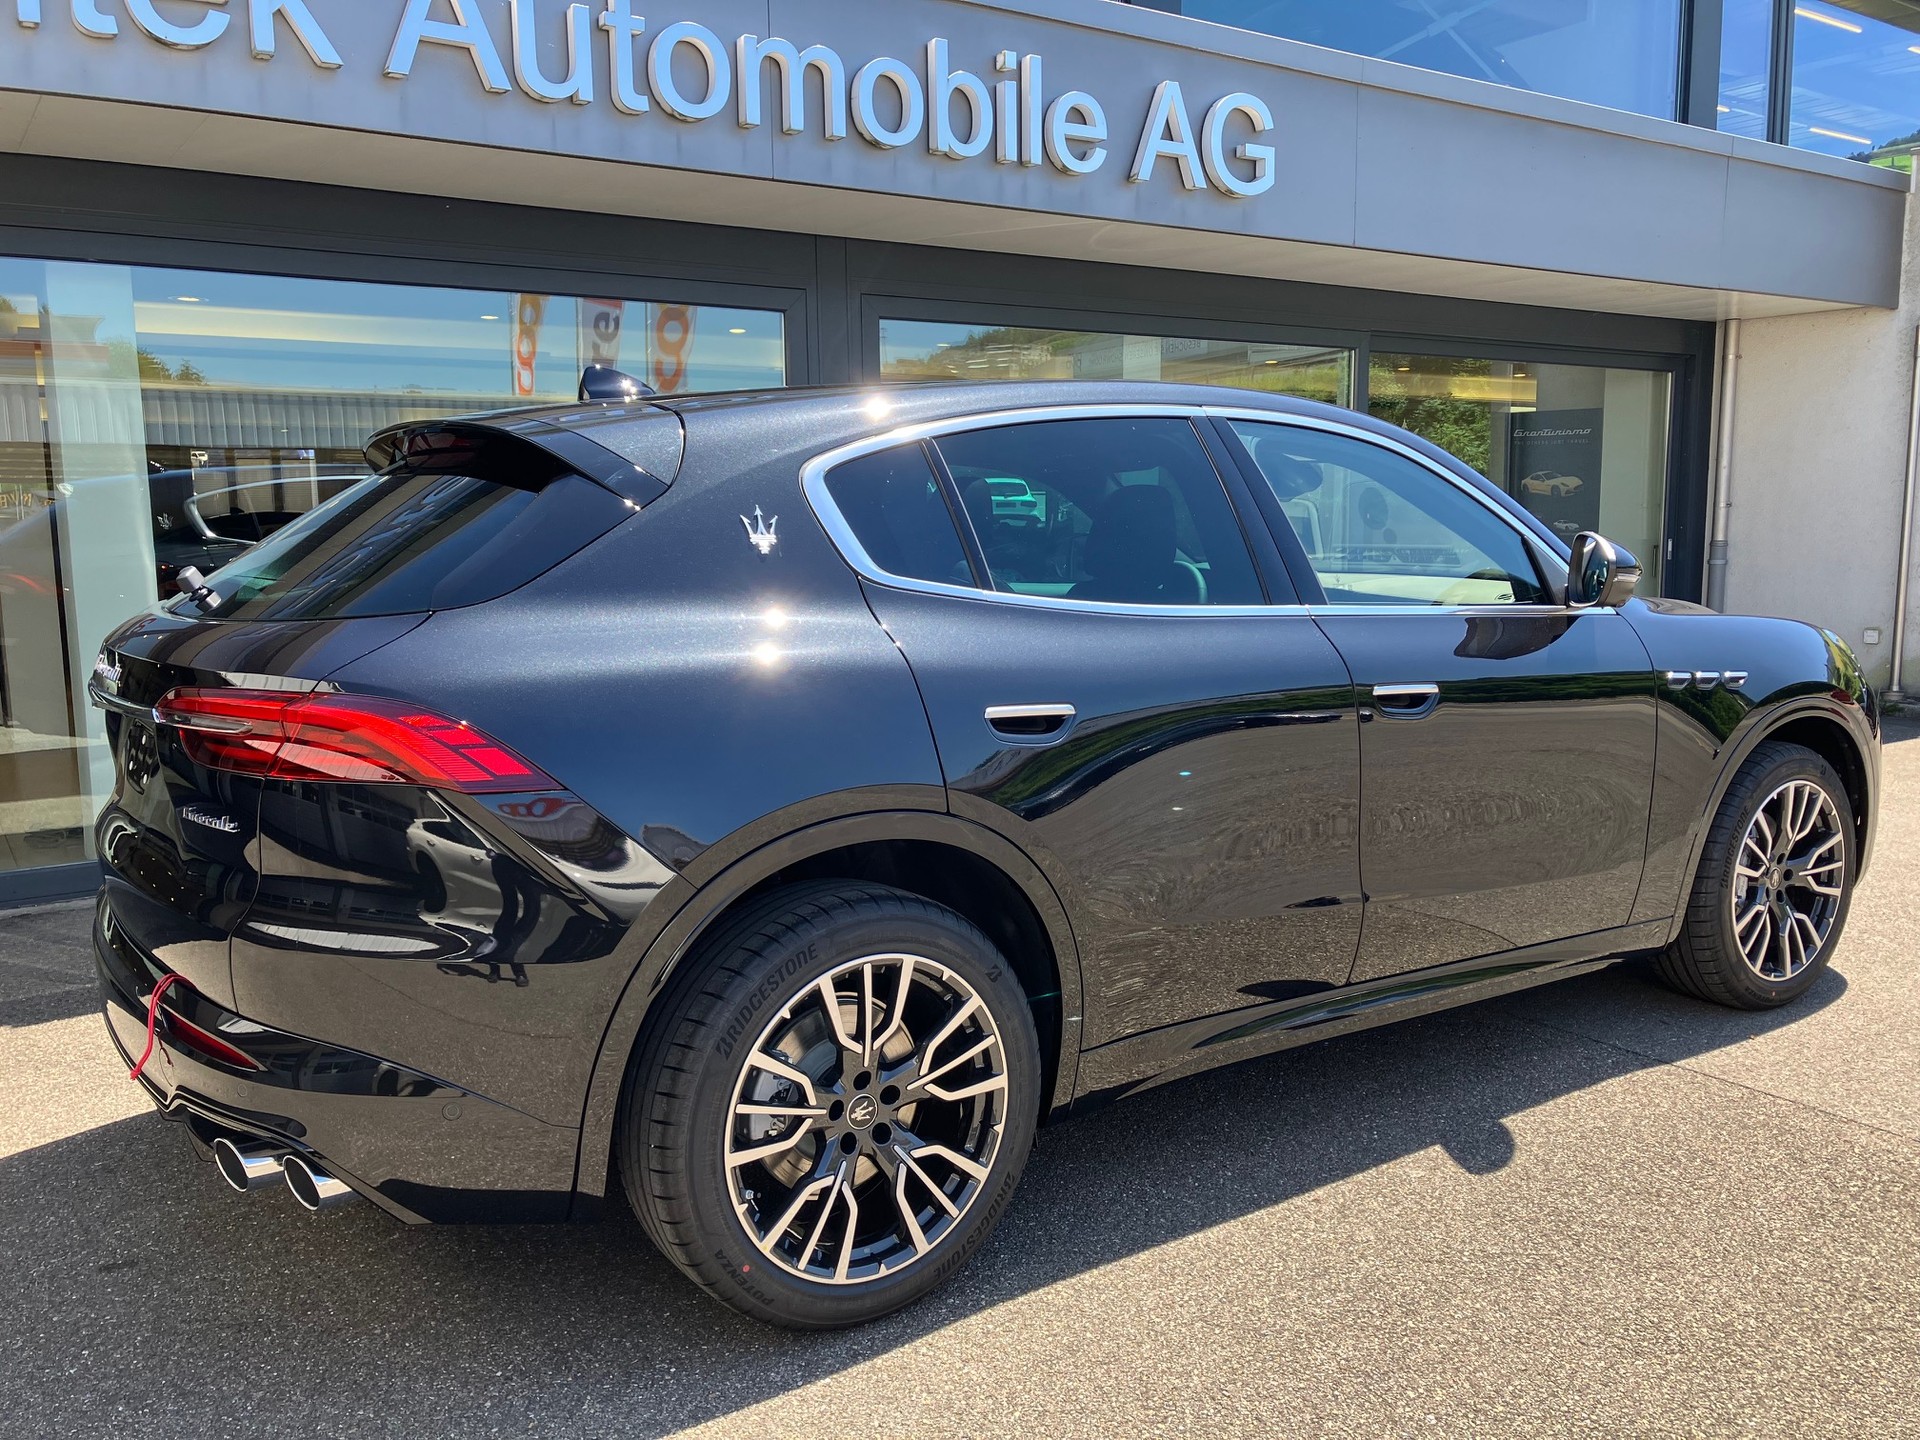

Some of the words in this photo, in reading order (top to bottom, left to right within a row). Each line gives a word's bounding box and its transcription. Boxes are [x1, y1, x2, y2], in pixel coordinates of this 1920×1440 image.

[383, 0, 1108, 177] Automobile
[1129, 80, 1275, 199] AG
[1720, 805, 1751, 890] BRIDGESTONE
[716, 942, 819, 1061] BRIDGESTONE
